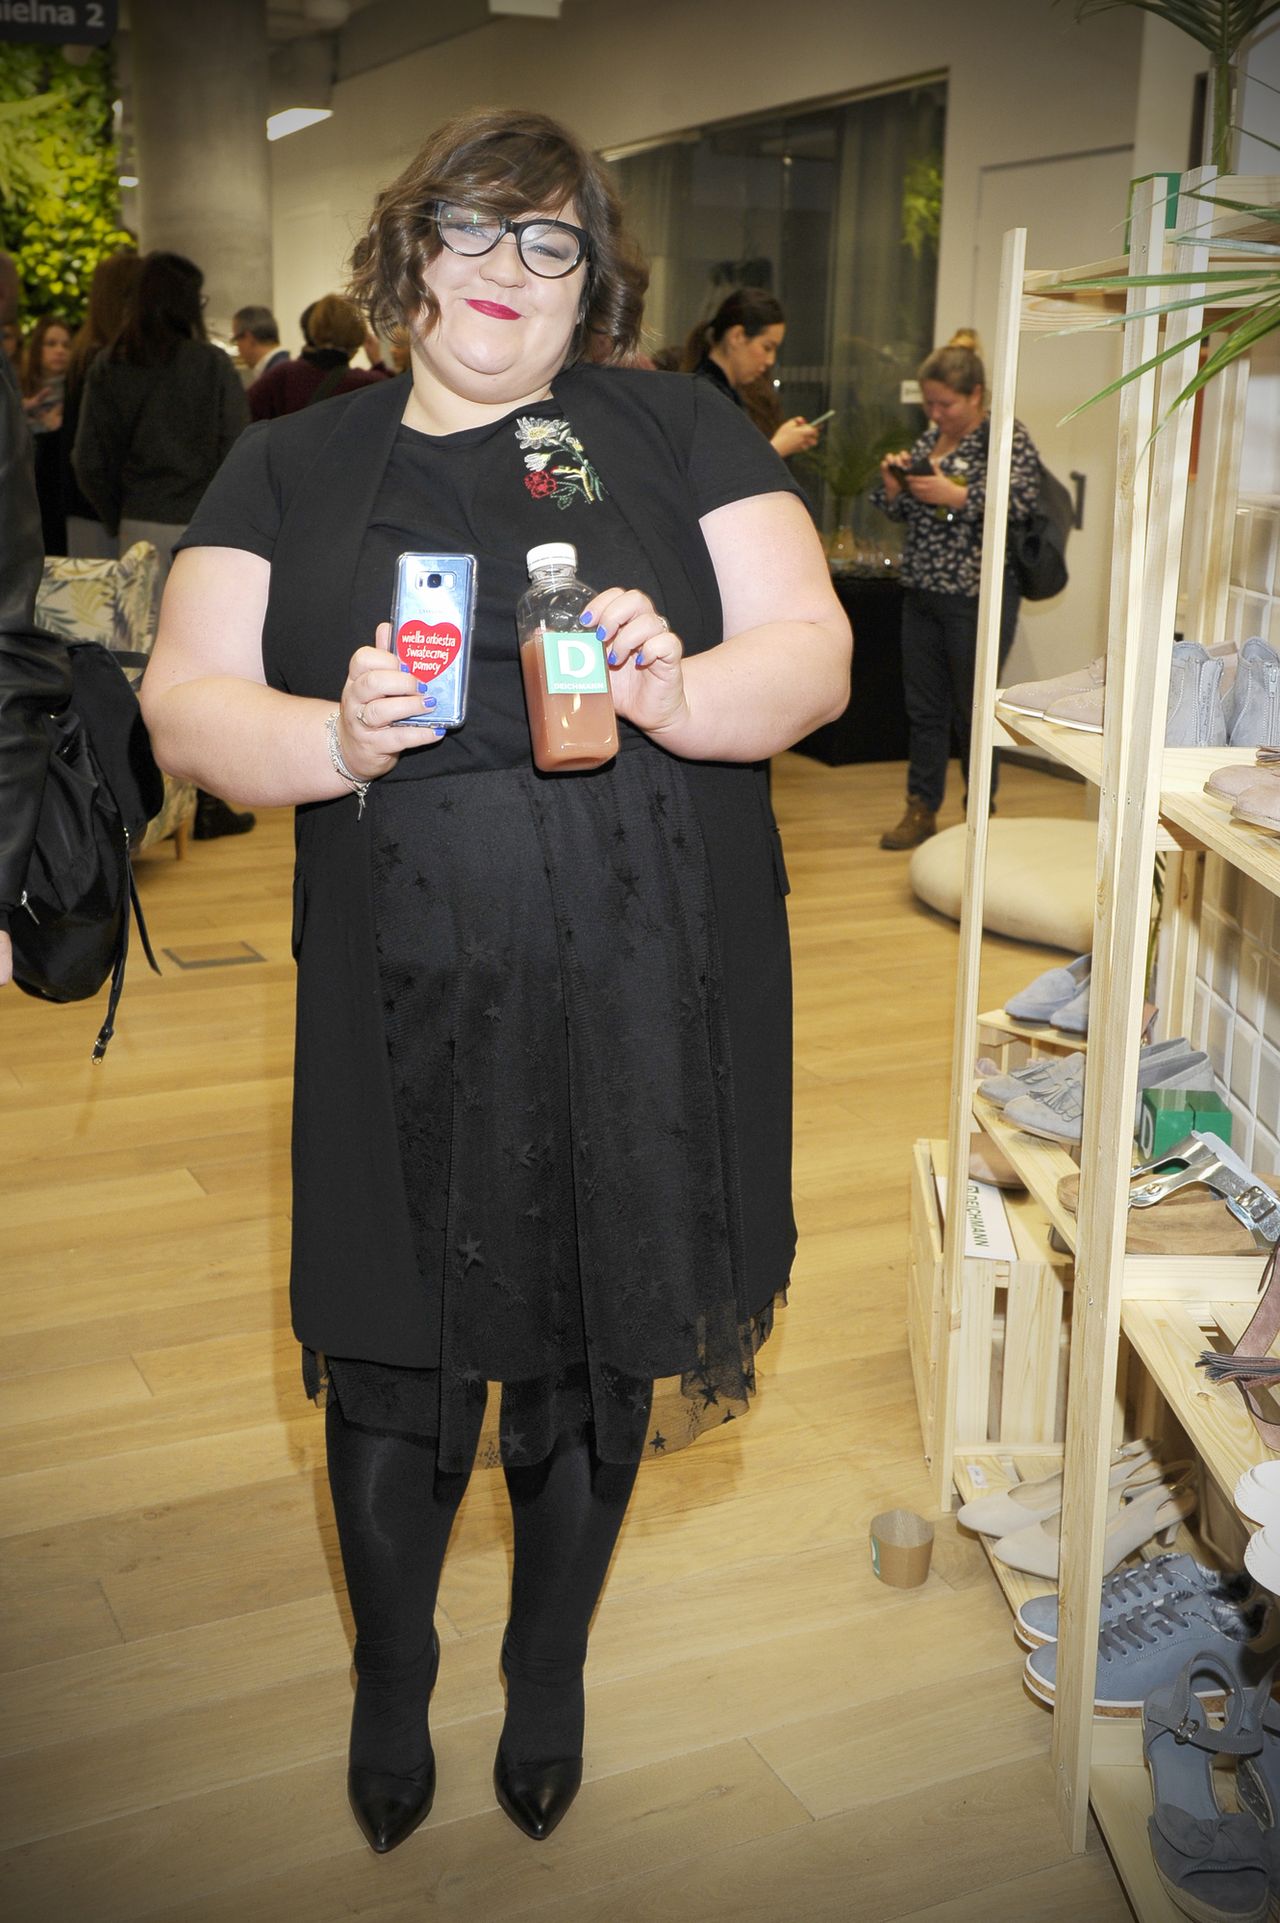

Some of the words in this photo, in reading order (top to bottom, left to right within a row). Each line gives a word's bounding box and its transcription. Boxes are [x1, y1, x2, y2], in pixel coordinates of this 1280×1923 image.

[0, 0, 75, 25] ielna
[86, 3, 104, 27] 2
[412, 660, 441, 675] pomocy
[557, 640, 596, 678] D
